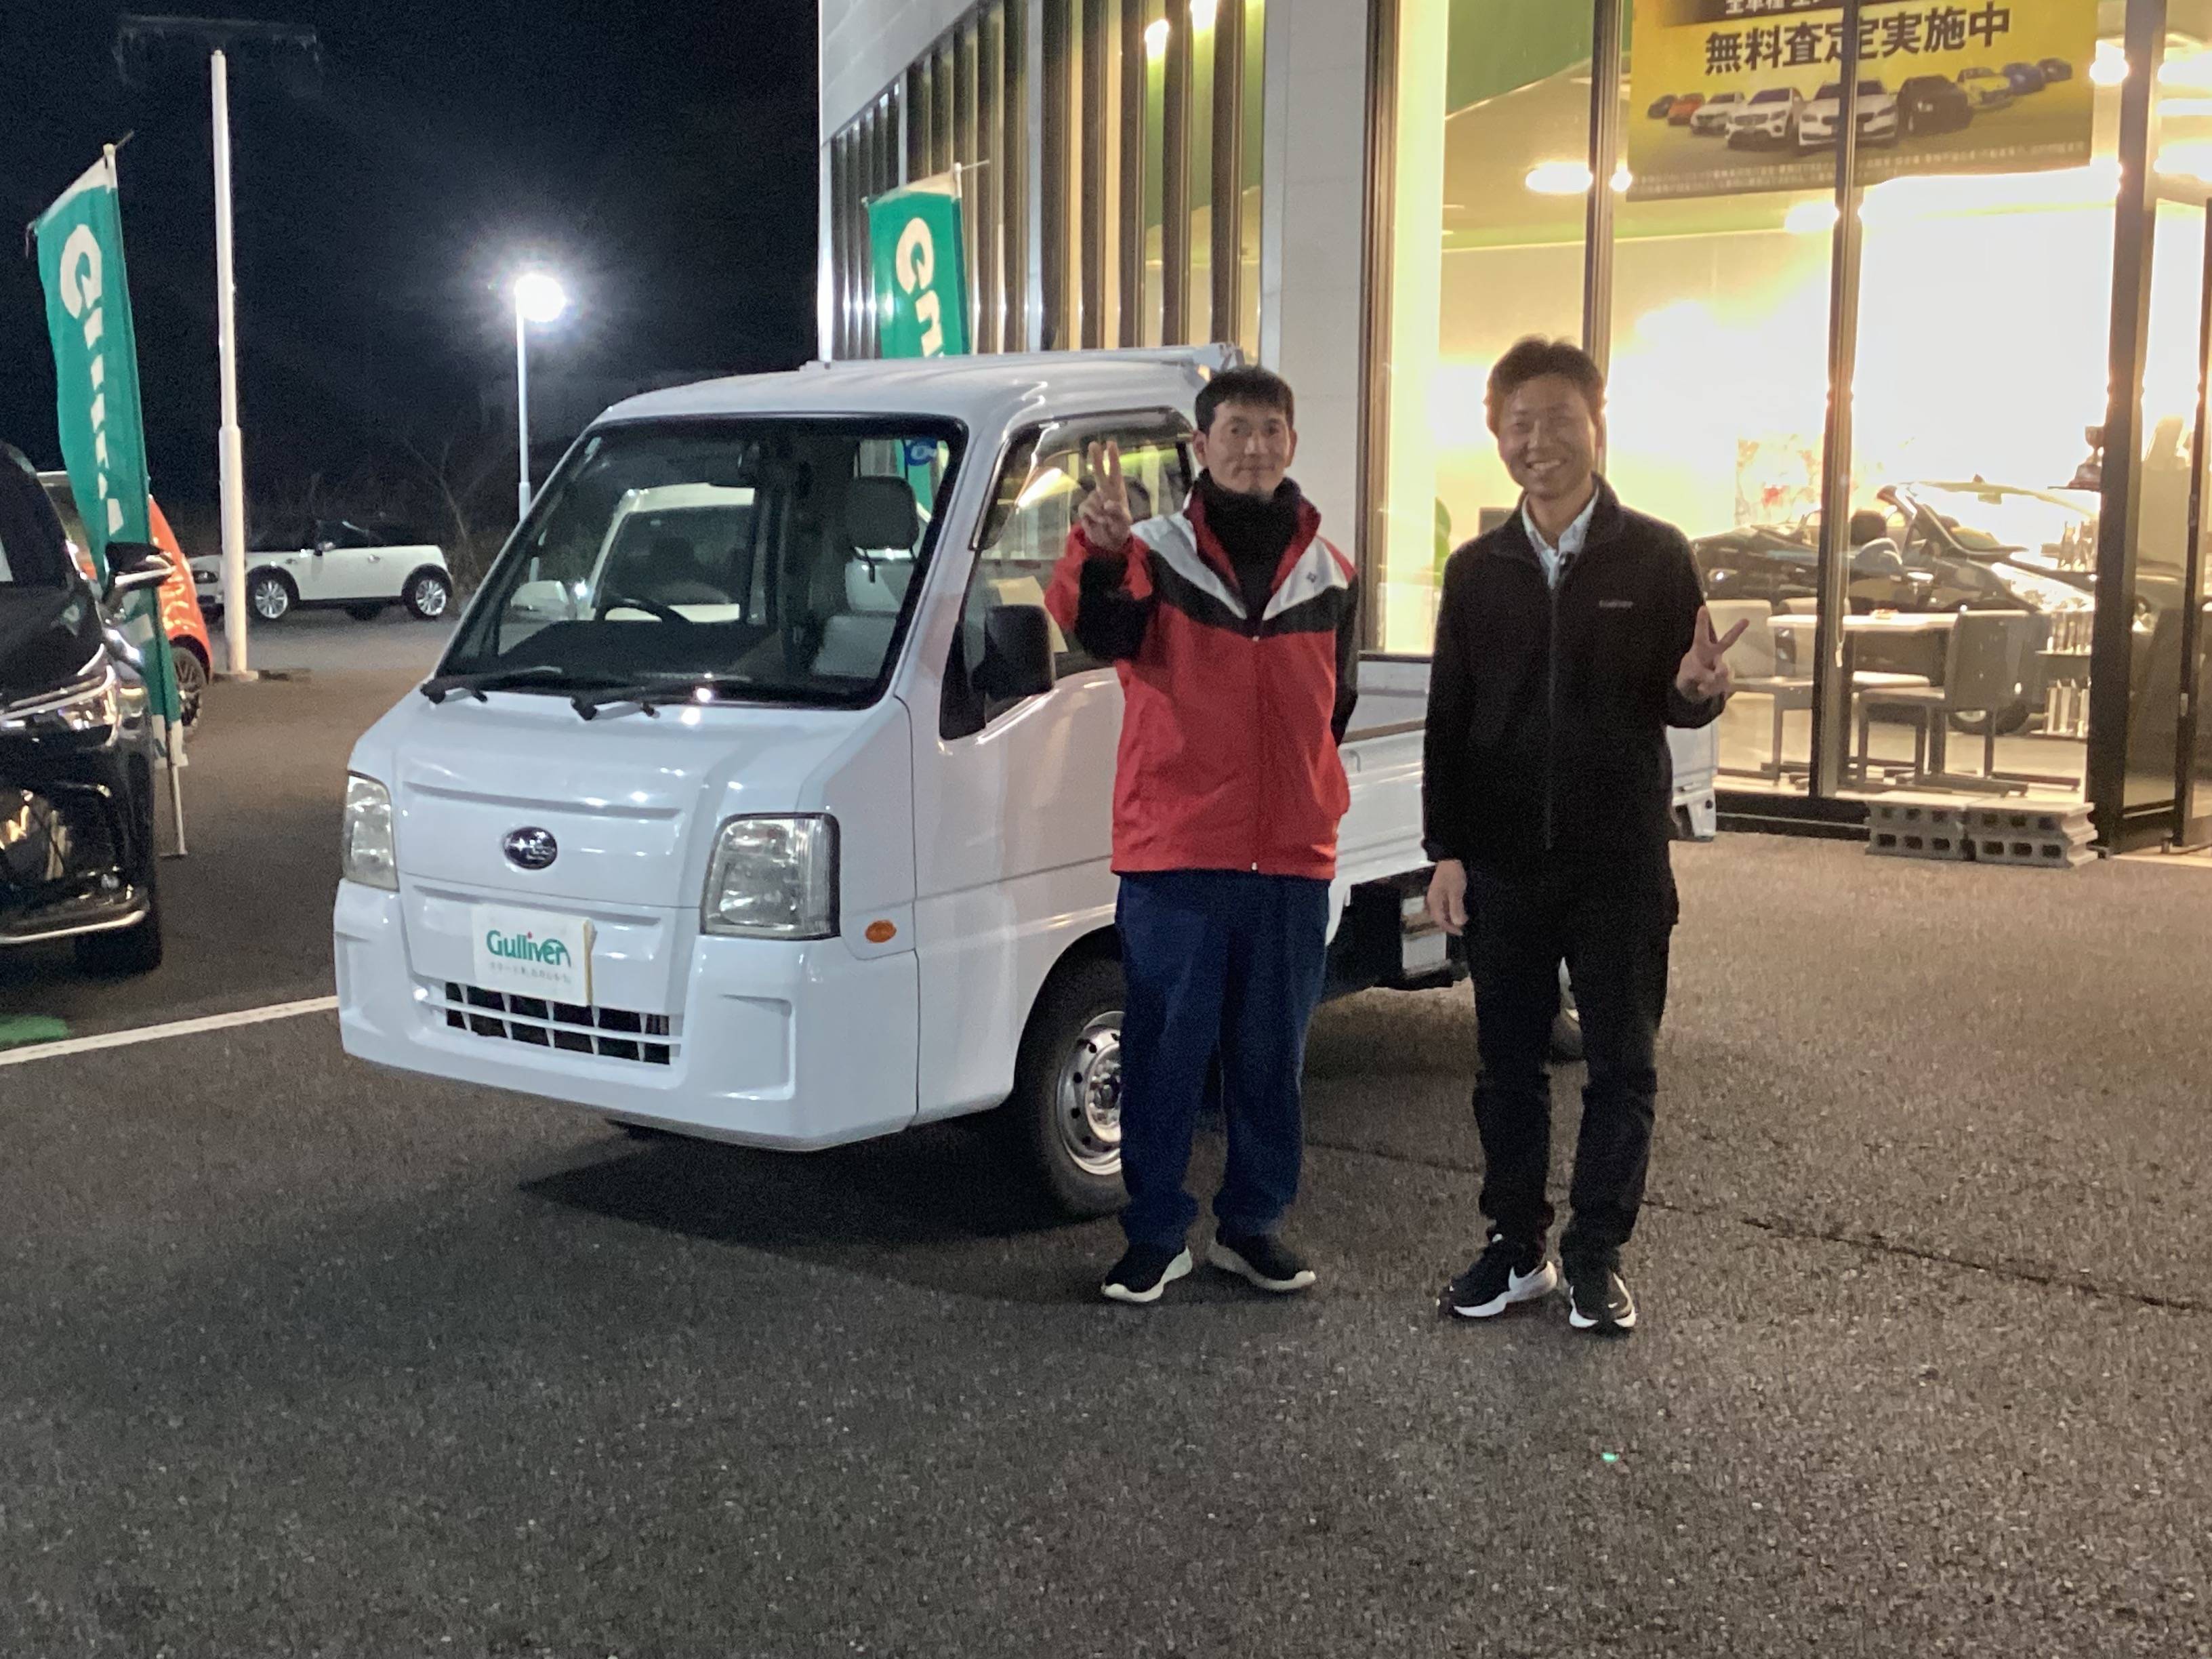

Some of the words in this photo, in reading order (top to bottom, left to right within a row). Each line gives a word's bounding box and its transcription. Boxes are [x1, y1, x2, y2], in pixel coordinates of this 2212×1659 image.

[1704, 1, 2011, 76] 無料査定実施中
[486, 929, 572, 968] Gulliver
